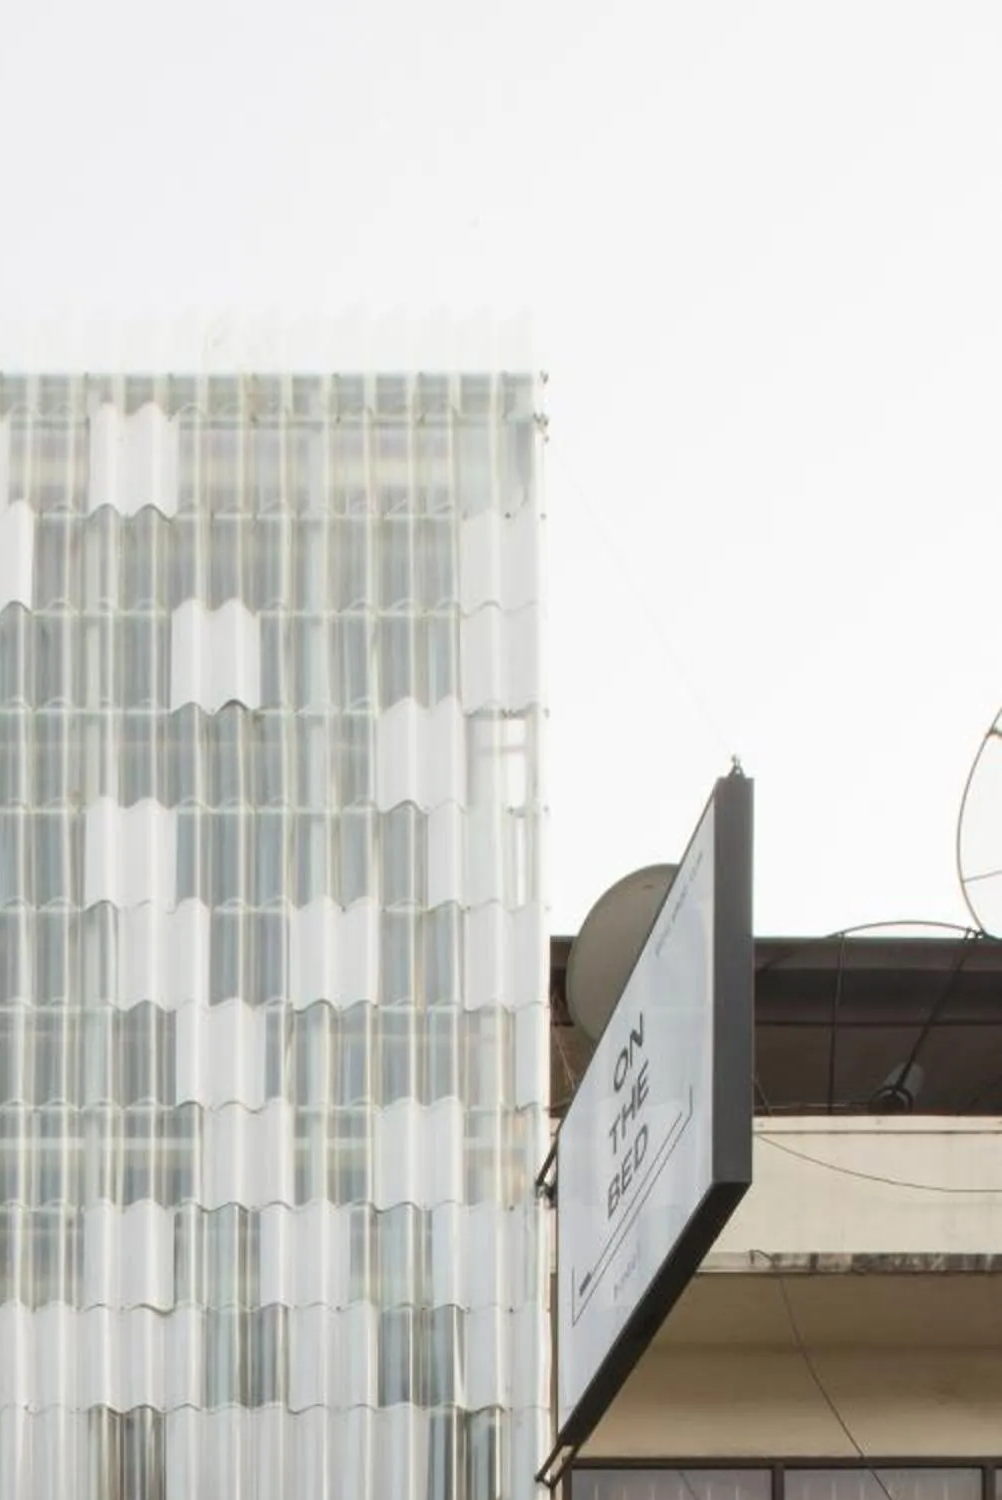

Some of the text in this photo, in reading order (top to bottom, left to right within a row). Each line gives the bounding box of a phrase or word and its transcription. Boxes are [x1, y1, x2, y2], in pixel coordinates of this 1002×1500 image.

[613, 1011, 644, 1094] ON
[609, 1059, 649, 1155] THE
[607, 1123, 649, 1220] BED
